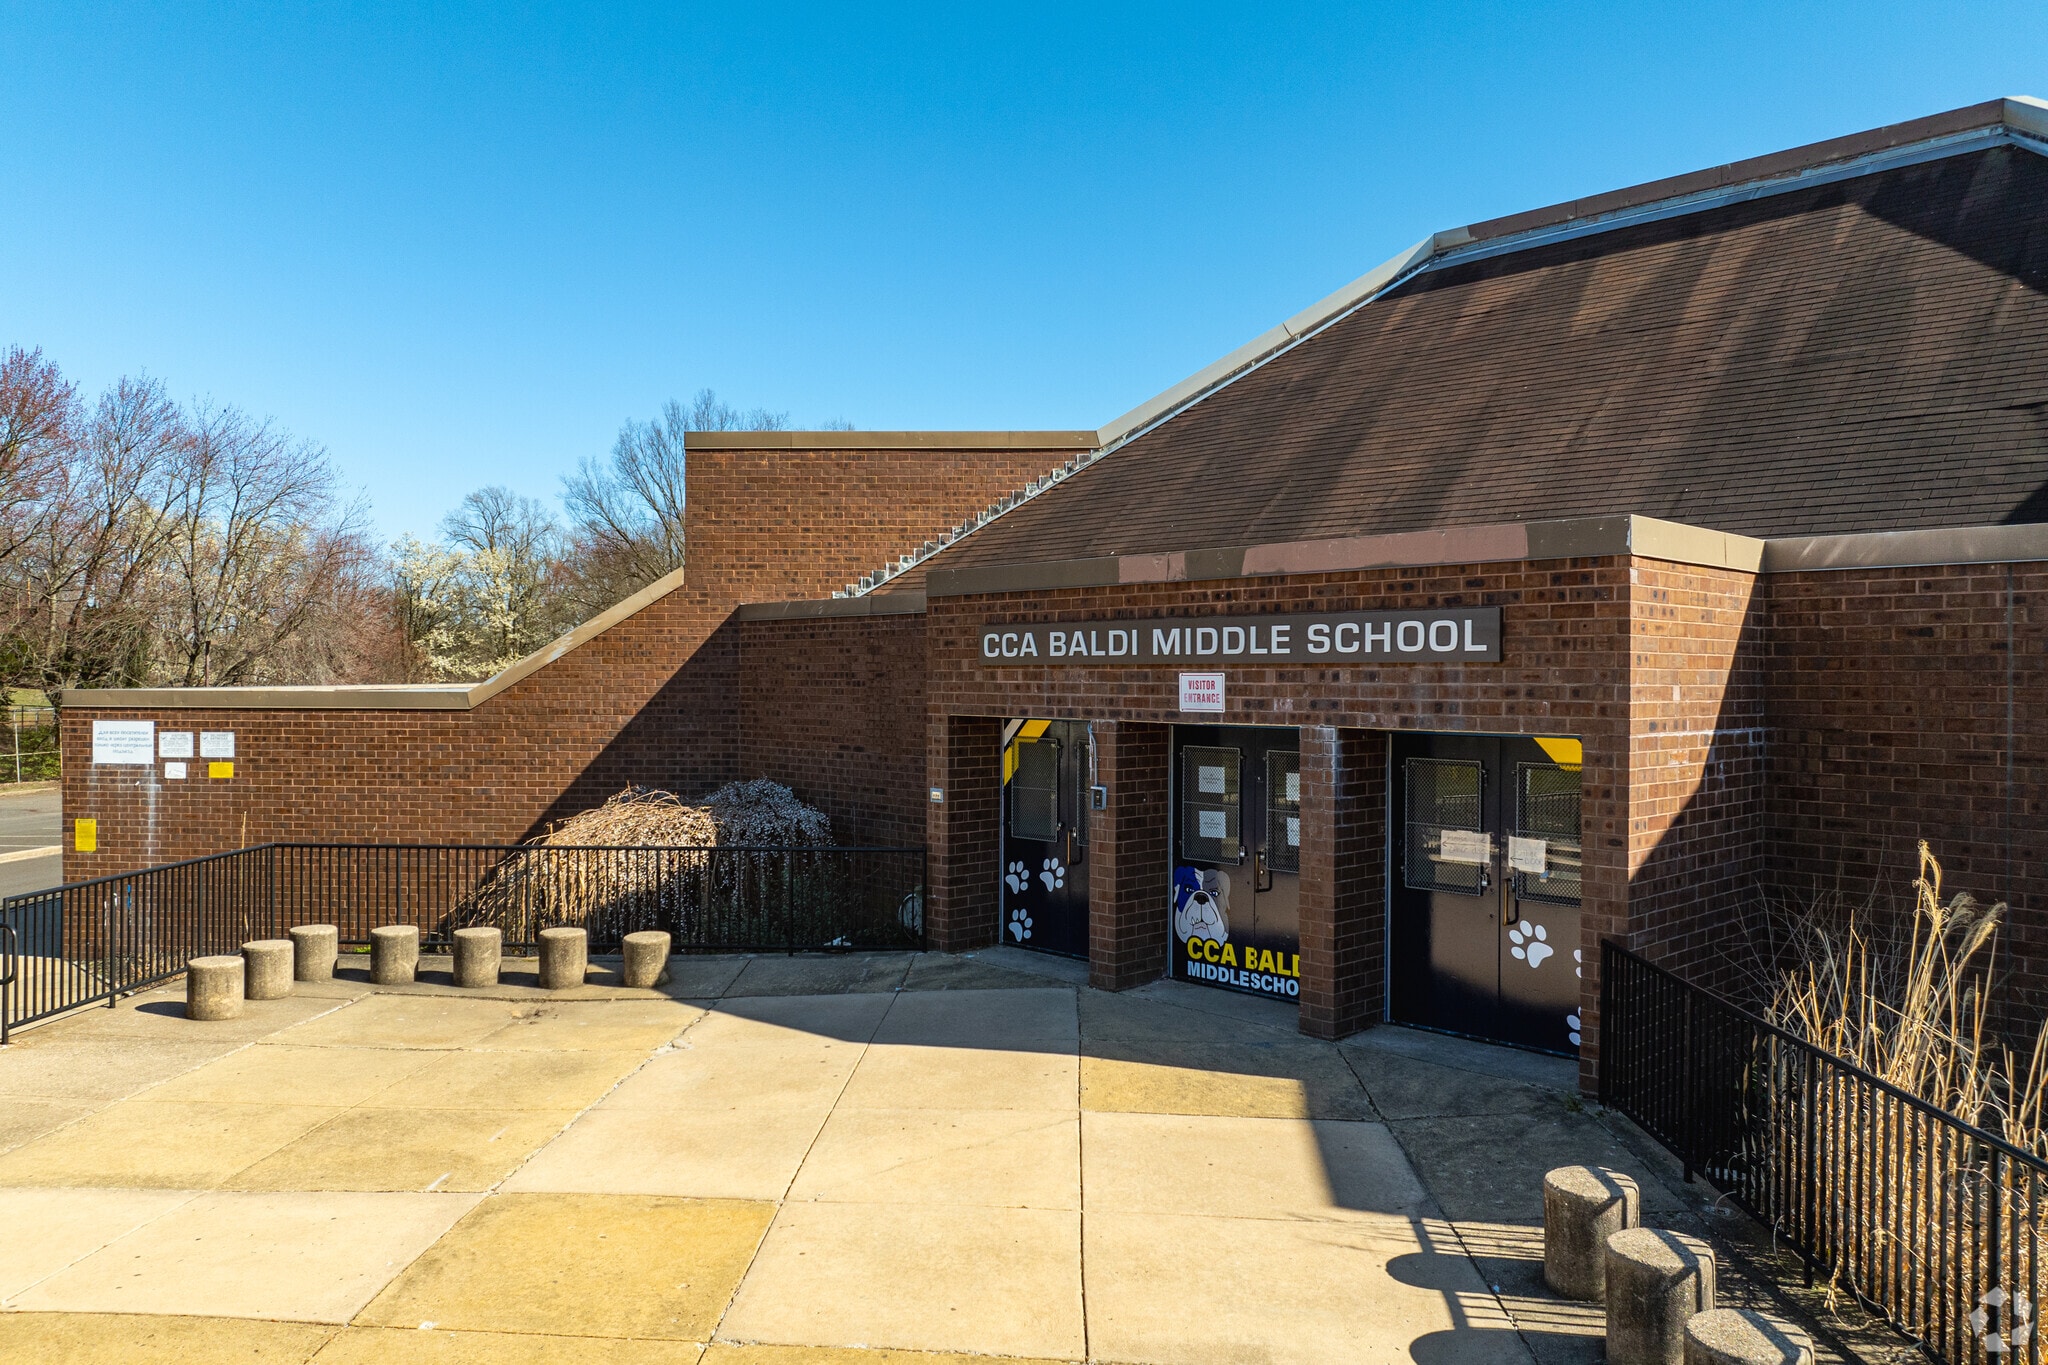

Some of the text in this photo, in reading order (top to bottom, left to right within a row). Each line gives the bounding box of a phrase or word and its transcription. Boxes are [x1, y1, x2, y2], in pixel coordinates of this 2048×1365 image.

[982, 619, 1488, 658] CCA BALDI MIDDLE SCHOOL
[1187, 679, 1216, 690] VISITOR
[1183, 692, 1221, 704] ENTRANCE
[1187, 936, 1238, 967] CCA
